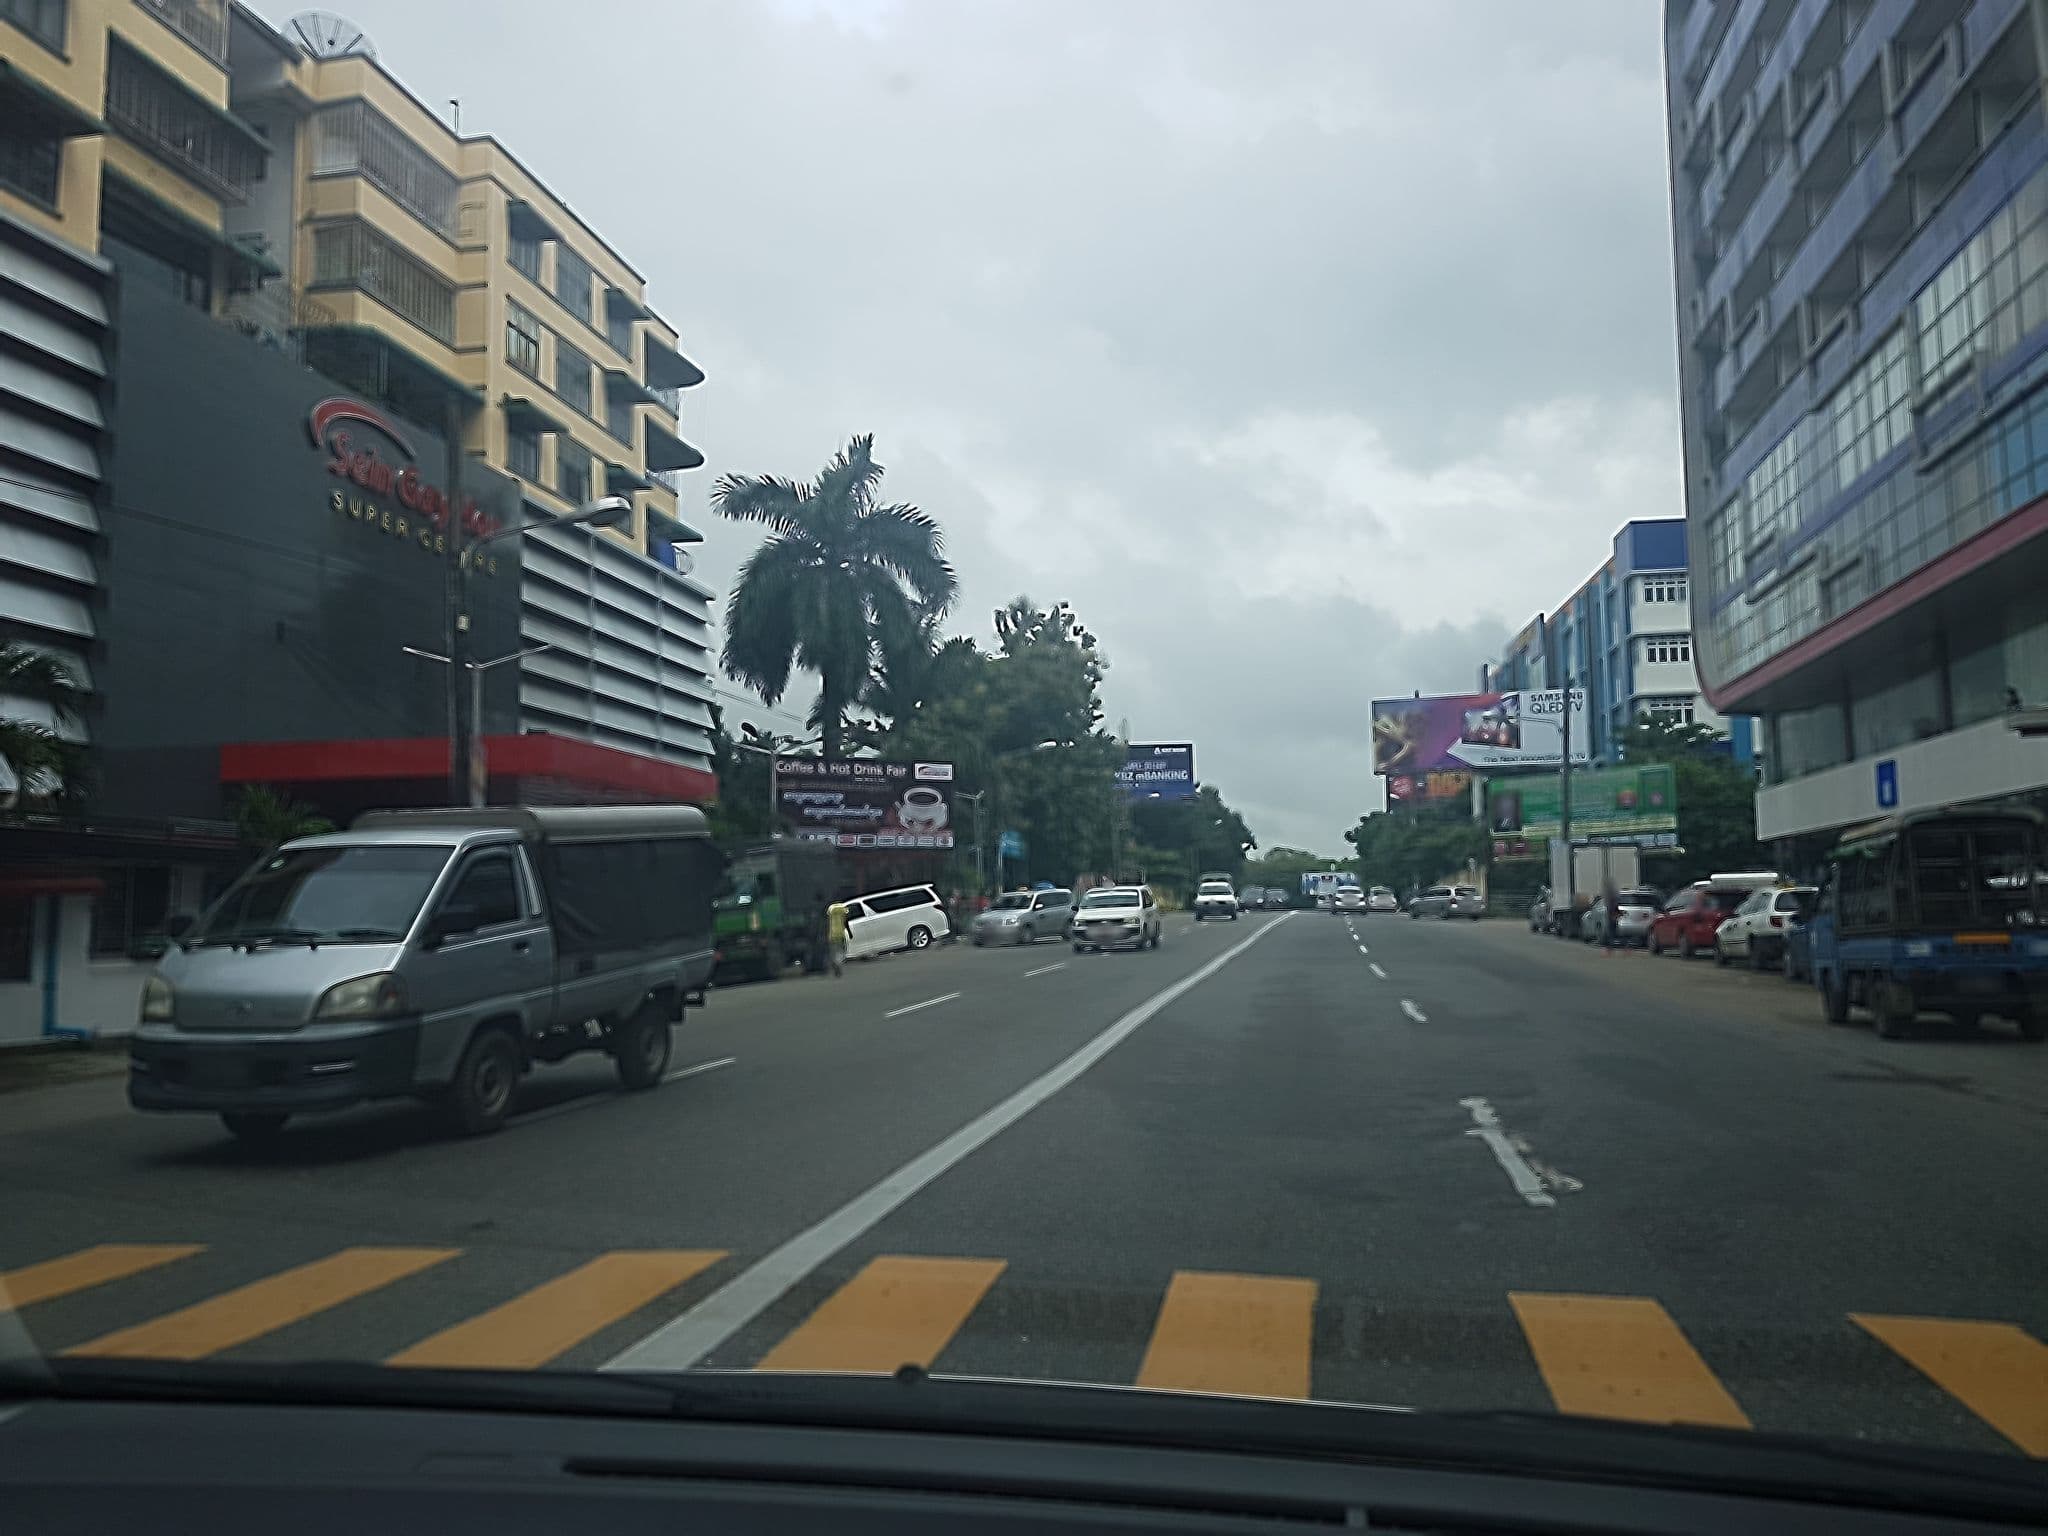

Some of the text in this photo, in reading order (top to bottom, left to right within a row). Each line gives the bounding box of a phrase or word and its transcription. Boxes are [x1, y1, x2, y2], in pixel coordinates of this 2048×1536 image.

[331, 488, 408, 537] SUPER
[1530, 702, 1563, 714] QLED
[776, 761, 814, 774] Coffee
[818, 762, 826, 774] &
[830, 763, 850, 775] Hot
[853, 763, 883, 776] Drink
[886, 765, 907, 776] Fair
[1135, 769, 1188, 781] mBANKING
